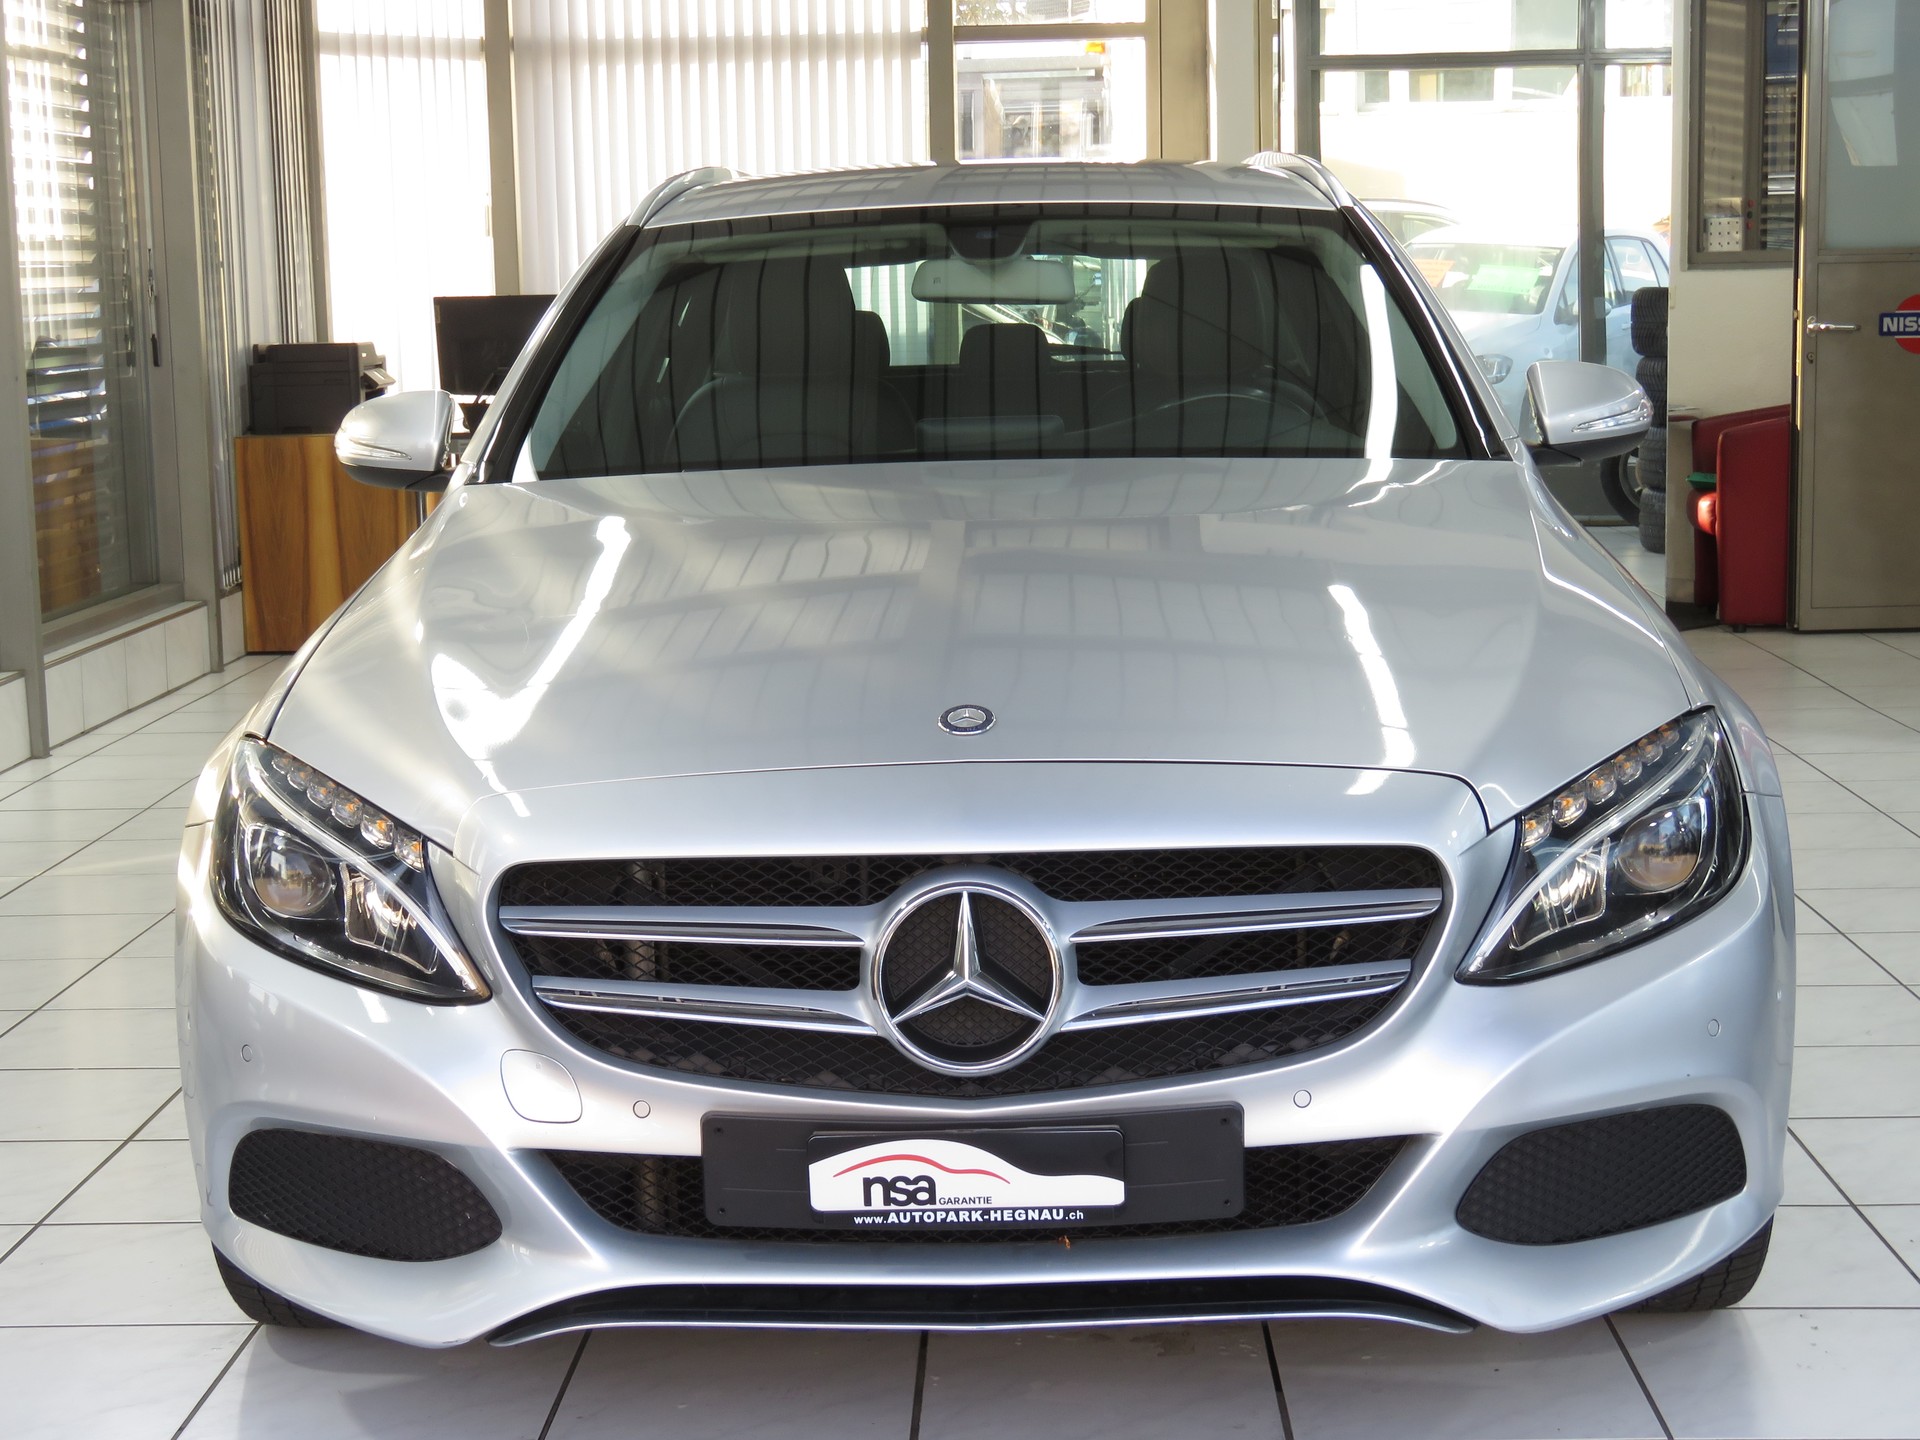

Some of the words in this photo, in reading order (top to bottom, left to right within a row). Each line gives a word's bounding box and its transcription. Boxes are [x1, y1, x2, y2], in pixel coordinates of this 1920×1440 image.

[1883, 316, 1920, 332] NIS
[862, 1175, 937, 1207] nsa
[938, 1196, 993, 1206] GARANTIE
[853, 1209, 1084, 1224] www.AUTOPARK-HEGNAU.ch
